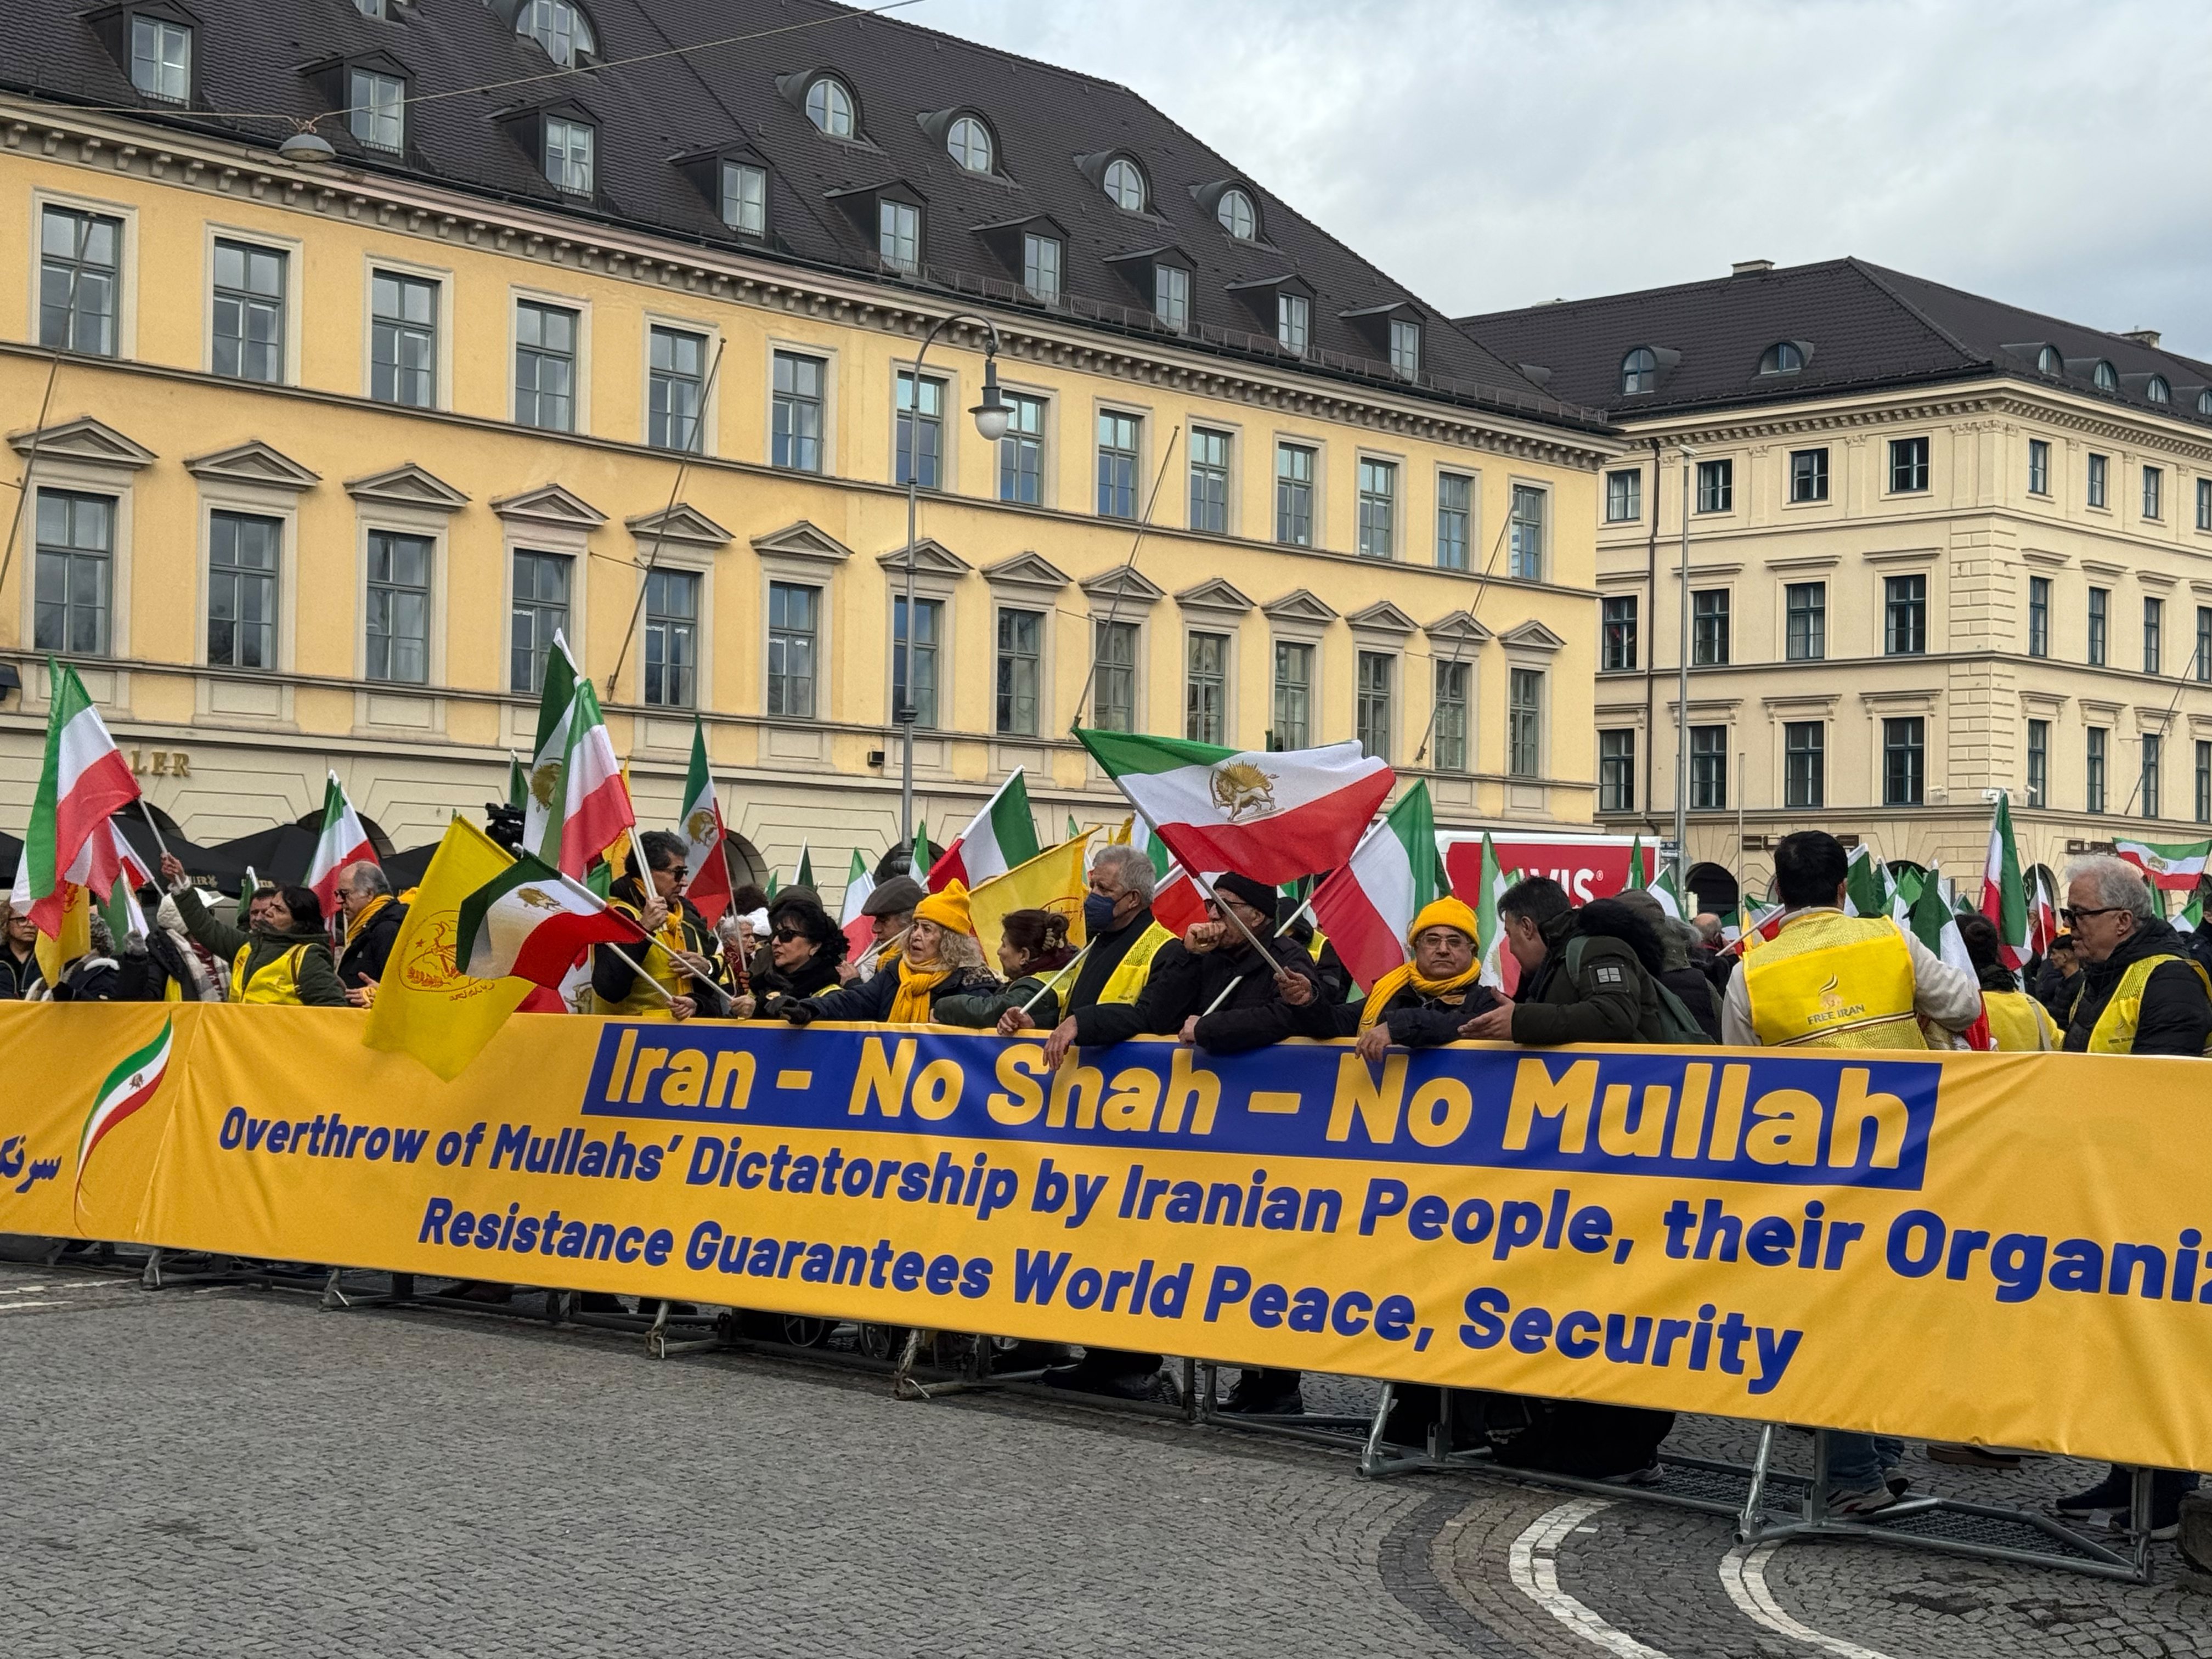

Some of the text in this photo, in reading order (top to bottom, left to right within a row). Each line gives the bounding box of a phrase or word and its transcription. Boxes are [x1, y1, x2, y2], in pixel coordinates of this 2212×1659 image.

[1807, 1004, 1865, 1025] FREE IRAN
[606, 1029, 755, 1108] Iran
[849, 1037, 963, 1119] No
[988, 1043, 1221, 1135] Shah
[1327, 1053, 1471, 1146] No
[1503, 1059, 1908, 1167] Mullah
[221, 1108, 426, 1160] Overthrow
[438, 1124, 483, 1164] of
[688, 1138, 1016, 1218] Dictatorship
[1033, 1160, 1106, 1227] by
[1120, 1166, 1340, 1231] Iranian
[1361, 1180, 1631, 1262] People,
[1665, 1200, 1863, 1268] their
[421, 1199, 1801, 1392] Resistance Guarantees World Peace, Security
